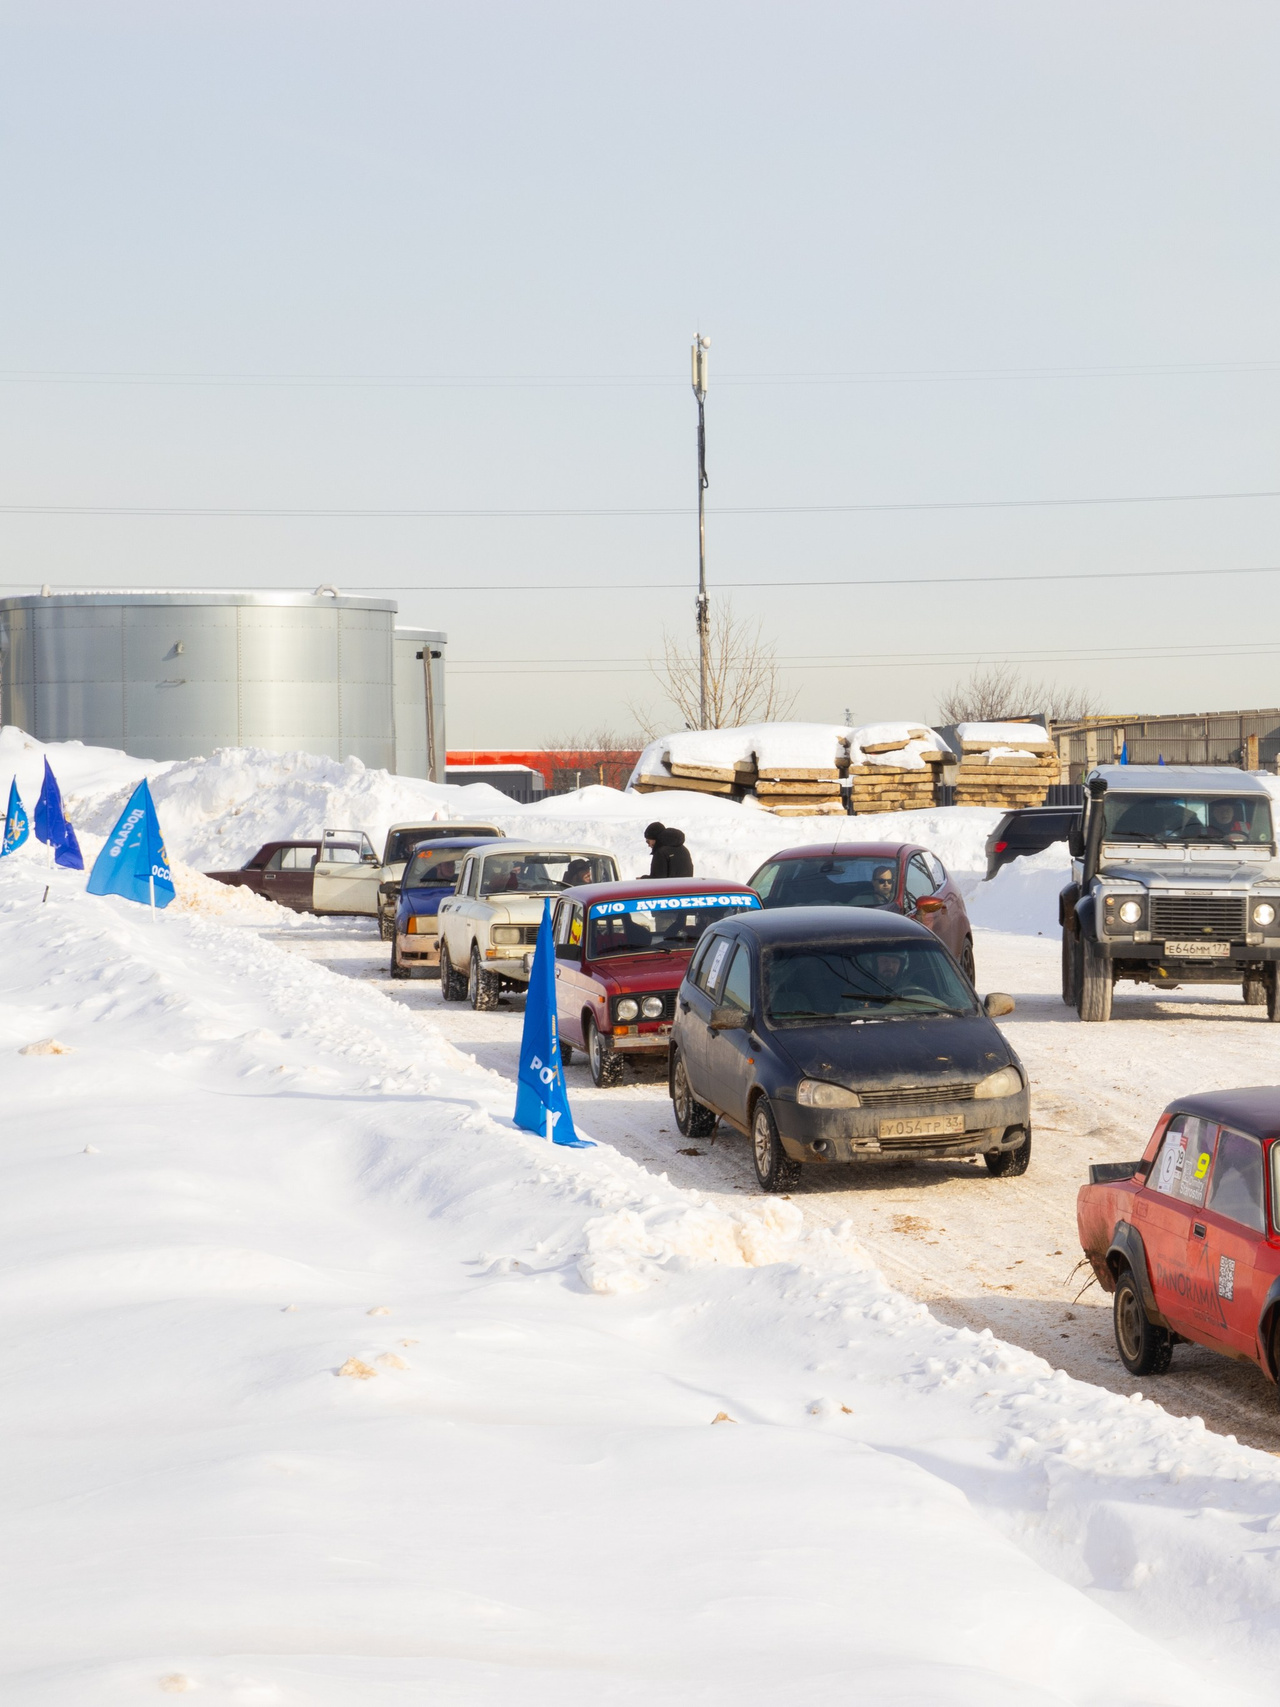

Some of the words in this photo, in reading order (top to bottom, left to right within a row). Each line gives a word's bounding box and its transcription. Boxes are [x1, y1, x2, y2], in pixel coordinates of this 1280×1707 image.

[596, 902, 625, 915] V/O
[636, 895, 753, 912] AVTOEXPORT
[1194, 1152, 1211, 1179] 9
[1156, 1263, 1218, 1313] PANORAMA
